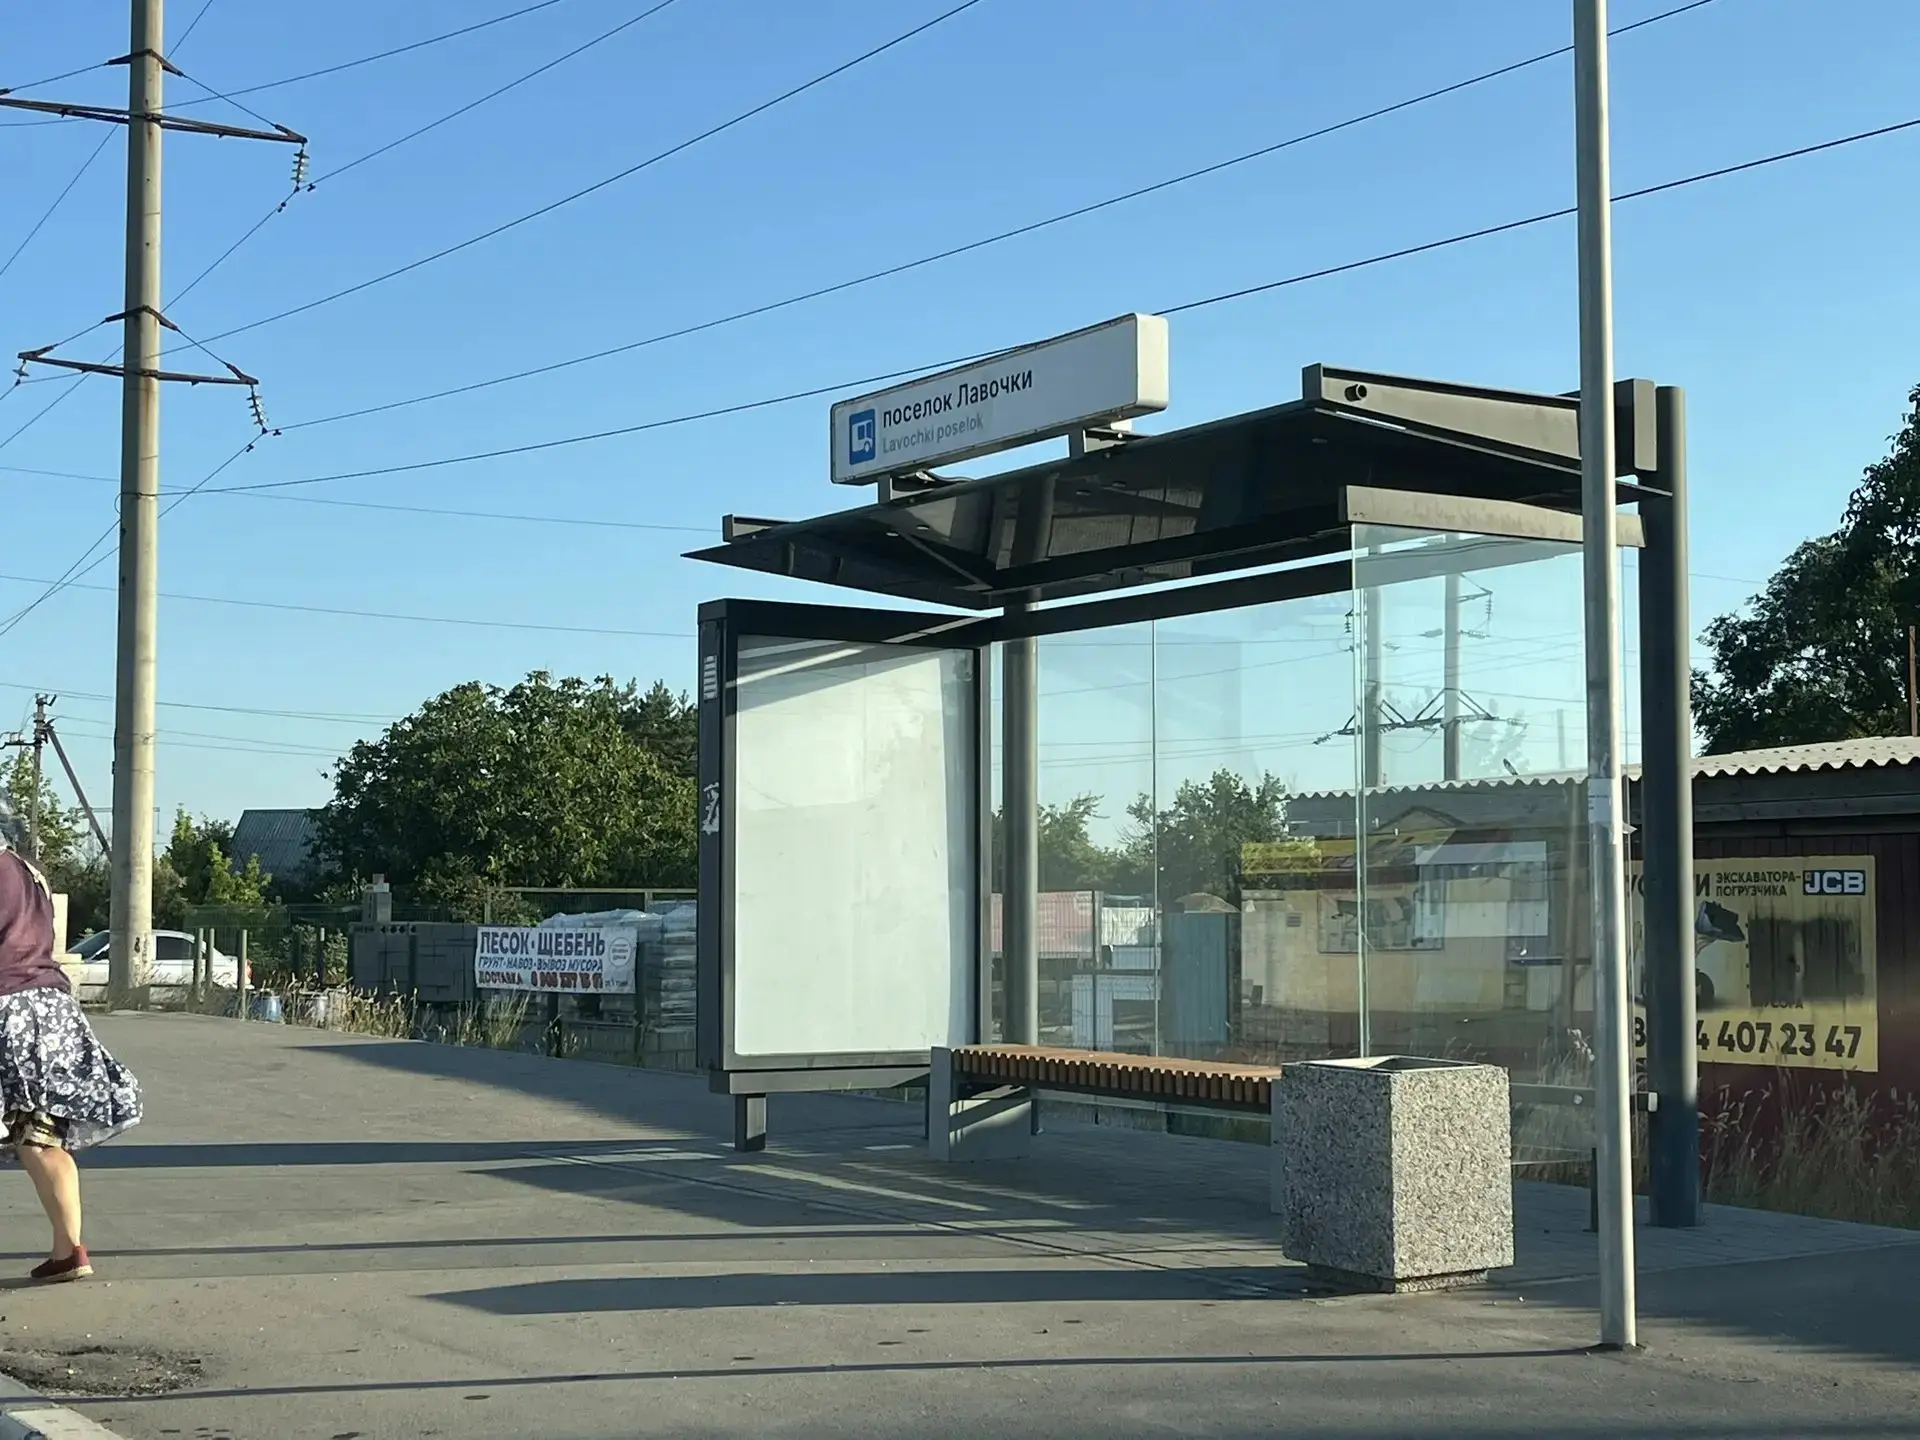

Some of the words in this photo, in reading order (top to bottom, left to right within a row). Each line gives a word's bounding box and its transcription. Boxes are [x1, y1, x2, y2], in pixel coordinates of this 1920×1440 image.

[883, 392, 953, 428] поселок
[957, 369, 1033, 408] Лавочки
[882, 427, 935, 454] Lavochki
[936, 412, 984, 443] poselok
[1716, 885, 1787, 897] ПОГРУЗЧИКА
[1804, 871, 1864, 894] JCB
[480, 931, 530, 955] ПЕСОК
[537, 931, 606, 958] ЩЕБЕНЬ
[1717, 1021, 1772, 1054] 407
[1780, 1023, 1817, 1057] 23
[1825, 1025, 1862, 1059] 47
